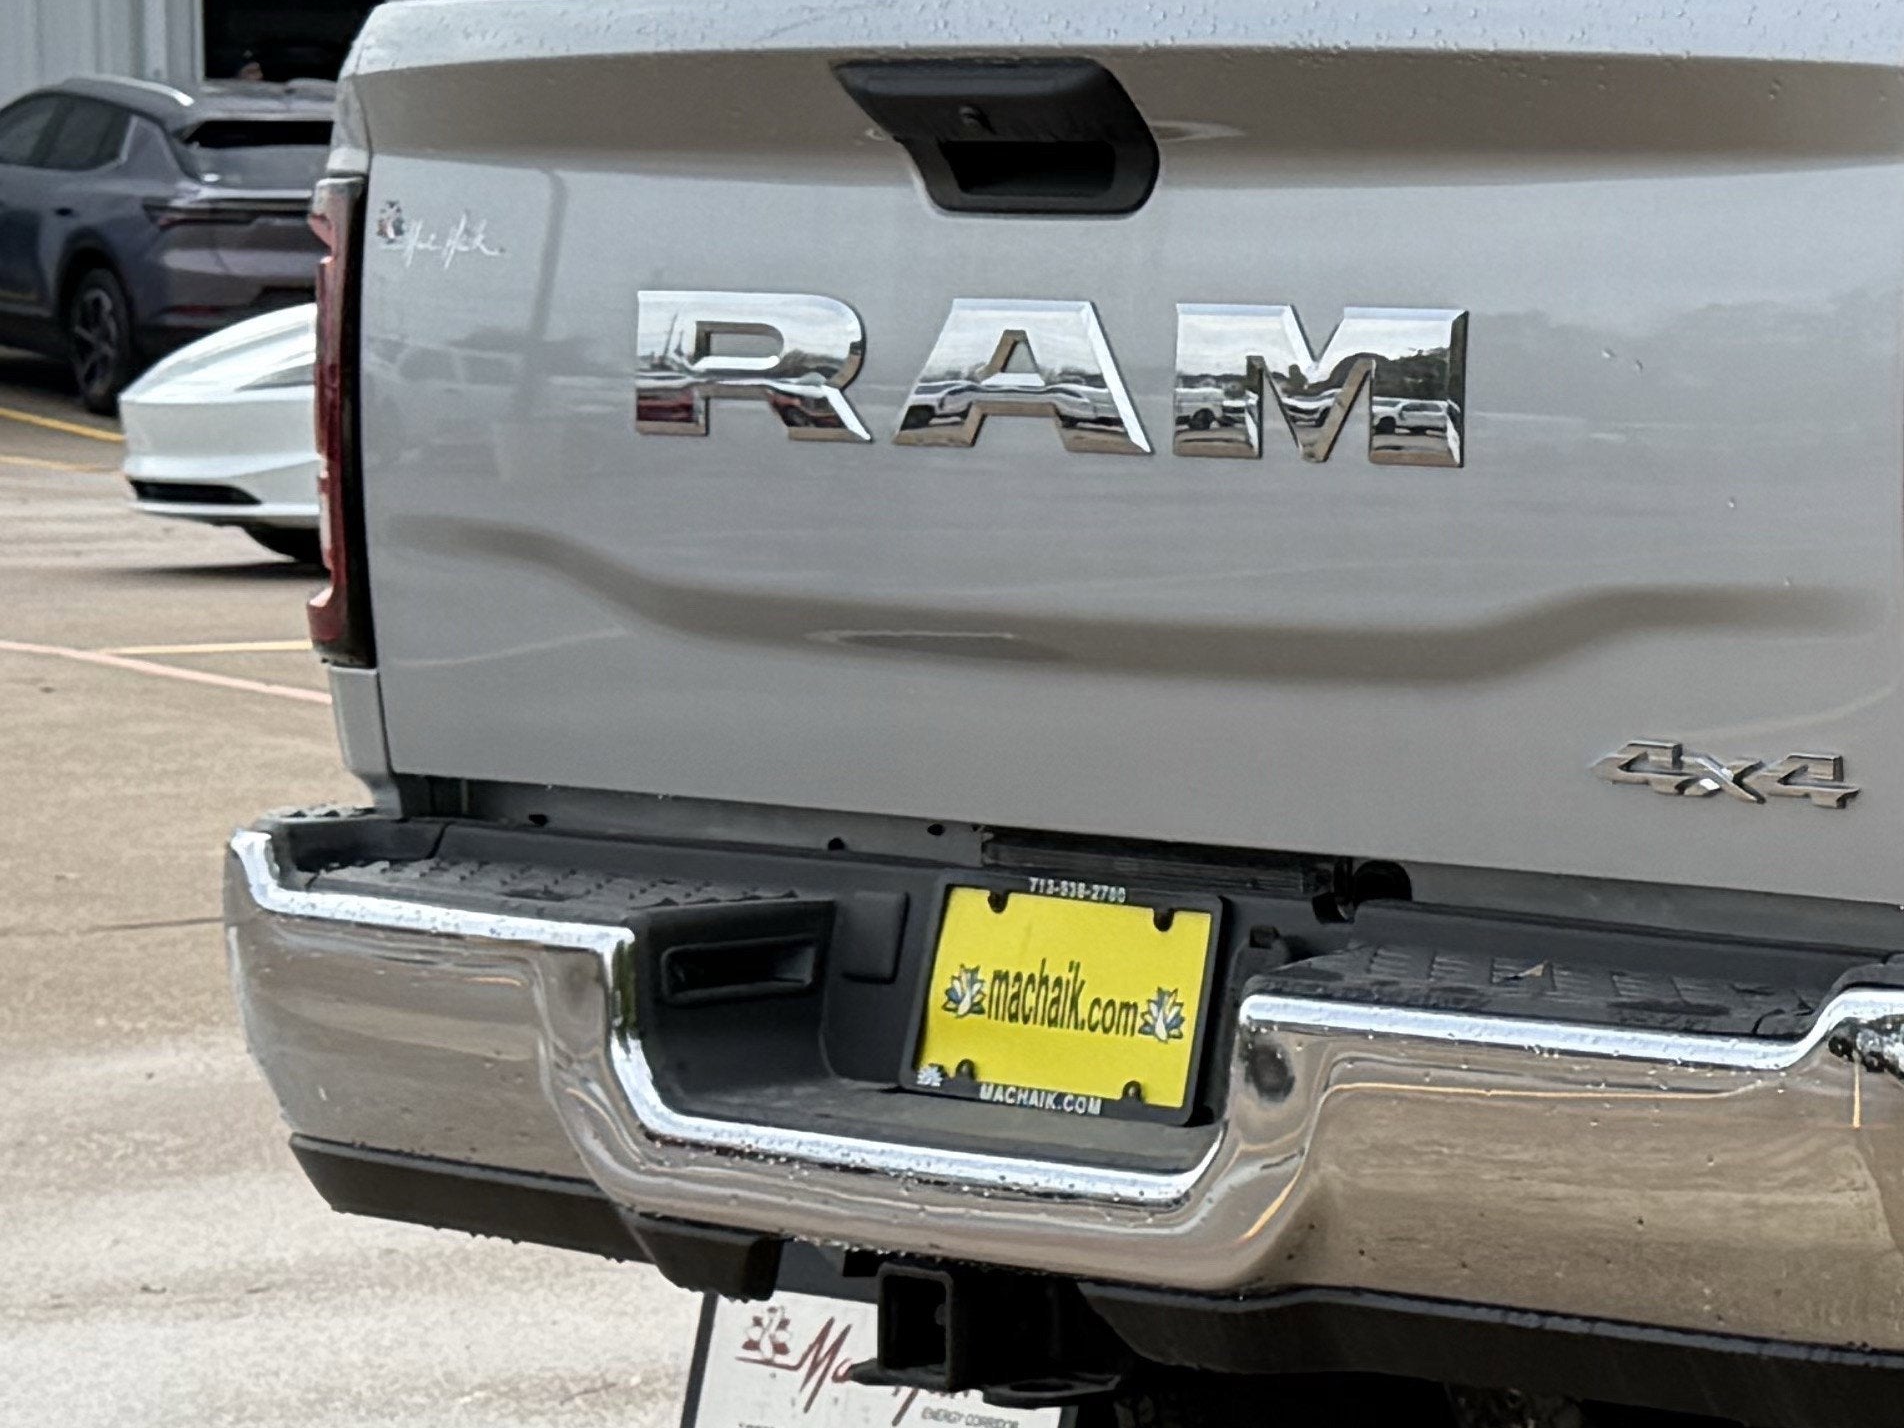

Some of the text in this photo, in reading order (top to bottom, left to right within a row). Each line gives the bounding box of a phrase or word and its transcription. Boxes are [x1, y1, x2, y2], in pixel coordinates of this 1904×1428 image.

[635, 289, 1470, 467] RAM
[987, 957, 1139, 1037] machaik.com
[979, 1083, 1102, 1115] MACHAIK.COM
